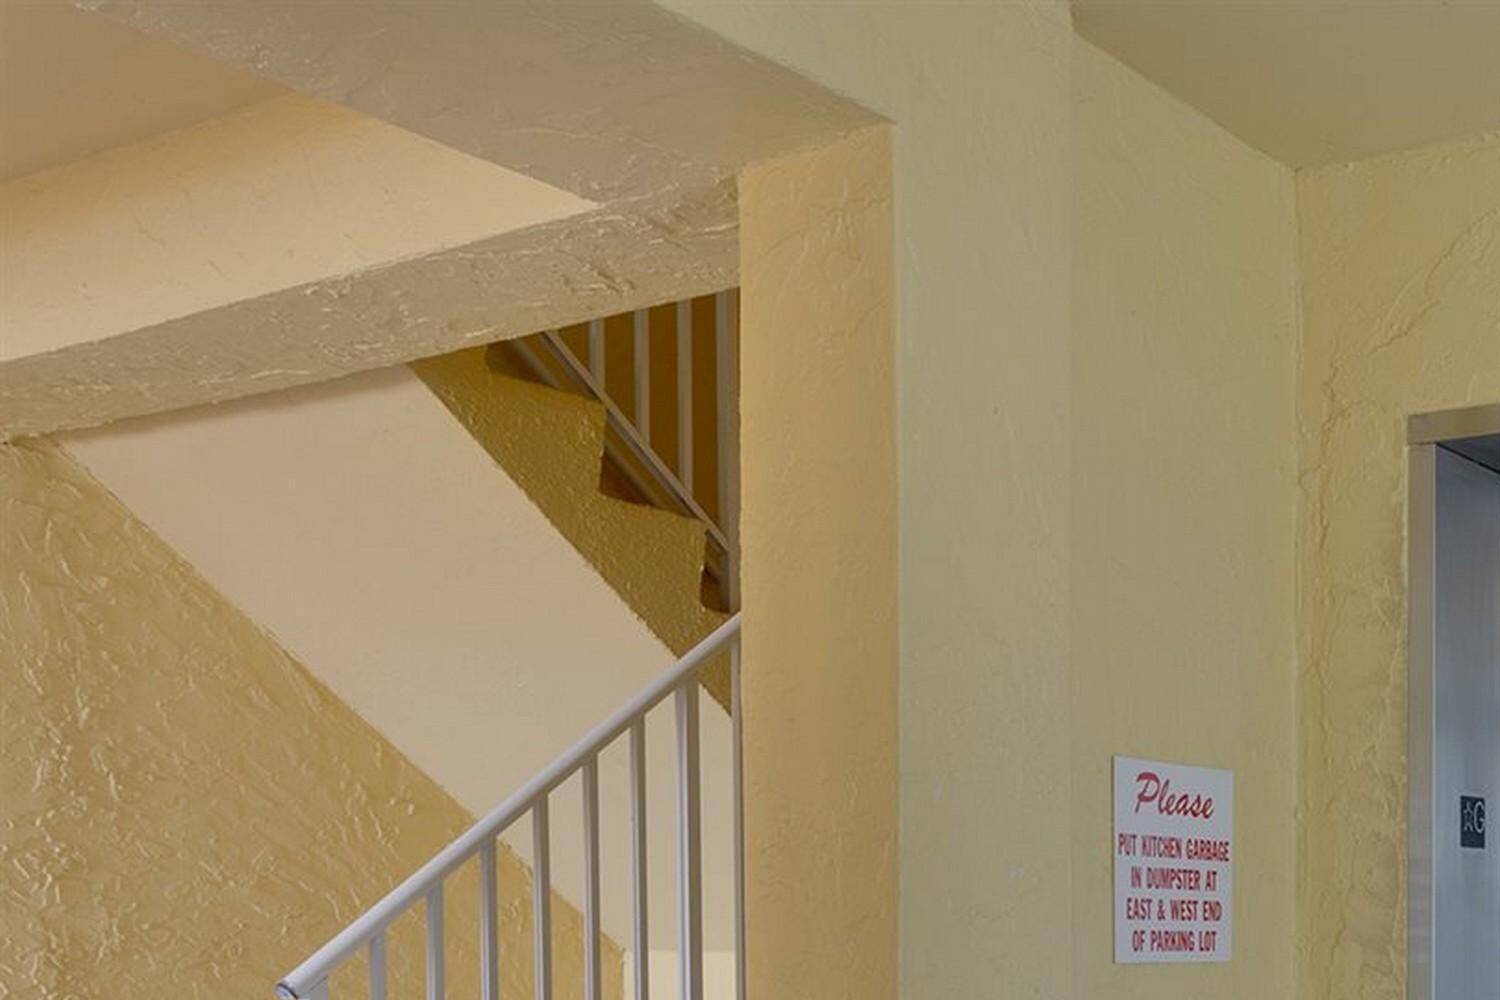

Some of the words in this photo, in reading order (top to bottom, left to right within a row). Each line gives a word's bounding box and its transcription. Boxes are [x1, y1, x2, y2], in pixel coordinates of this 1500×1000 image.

[1135, 772, 1214, 819] Please
[1118, 833, 1137, 856] PUT
[1142, 835, 1182, 859] KITCHEN
[1186, 838, 1229, 862] GARBAGE
[1131, 866, 1142, 888] IN
[1146, 867, 1200, 891] DUMPSTER
[1205, 870, 1217, 891] AT
[1127, 898, 1152, 920] EAST
[1157, 899, 1166, 920] &
[1170, 899, 1198, 921] WEST
[1203, 901, 1222, 921] END
[1133, 930, 1145, 952] OF
[1151, 930, 1195, 952] PARKING
[1199, 931, 1217, 952] LOT
